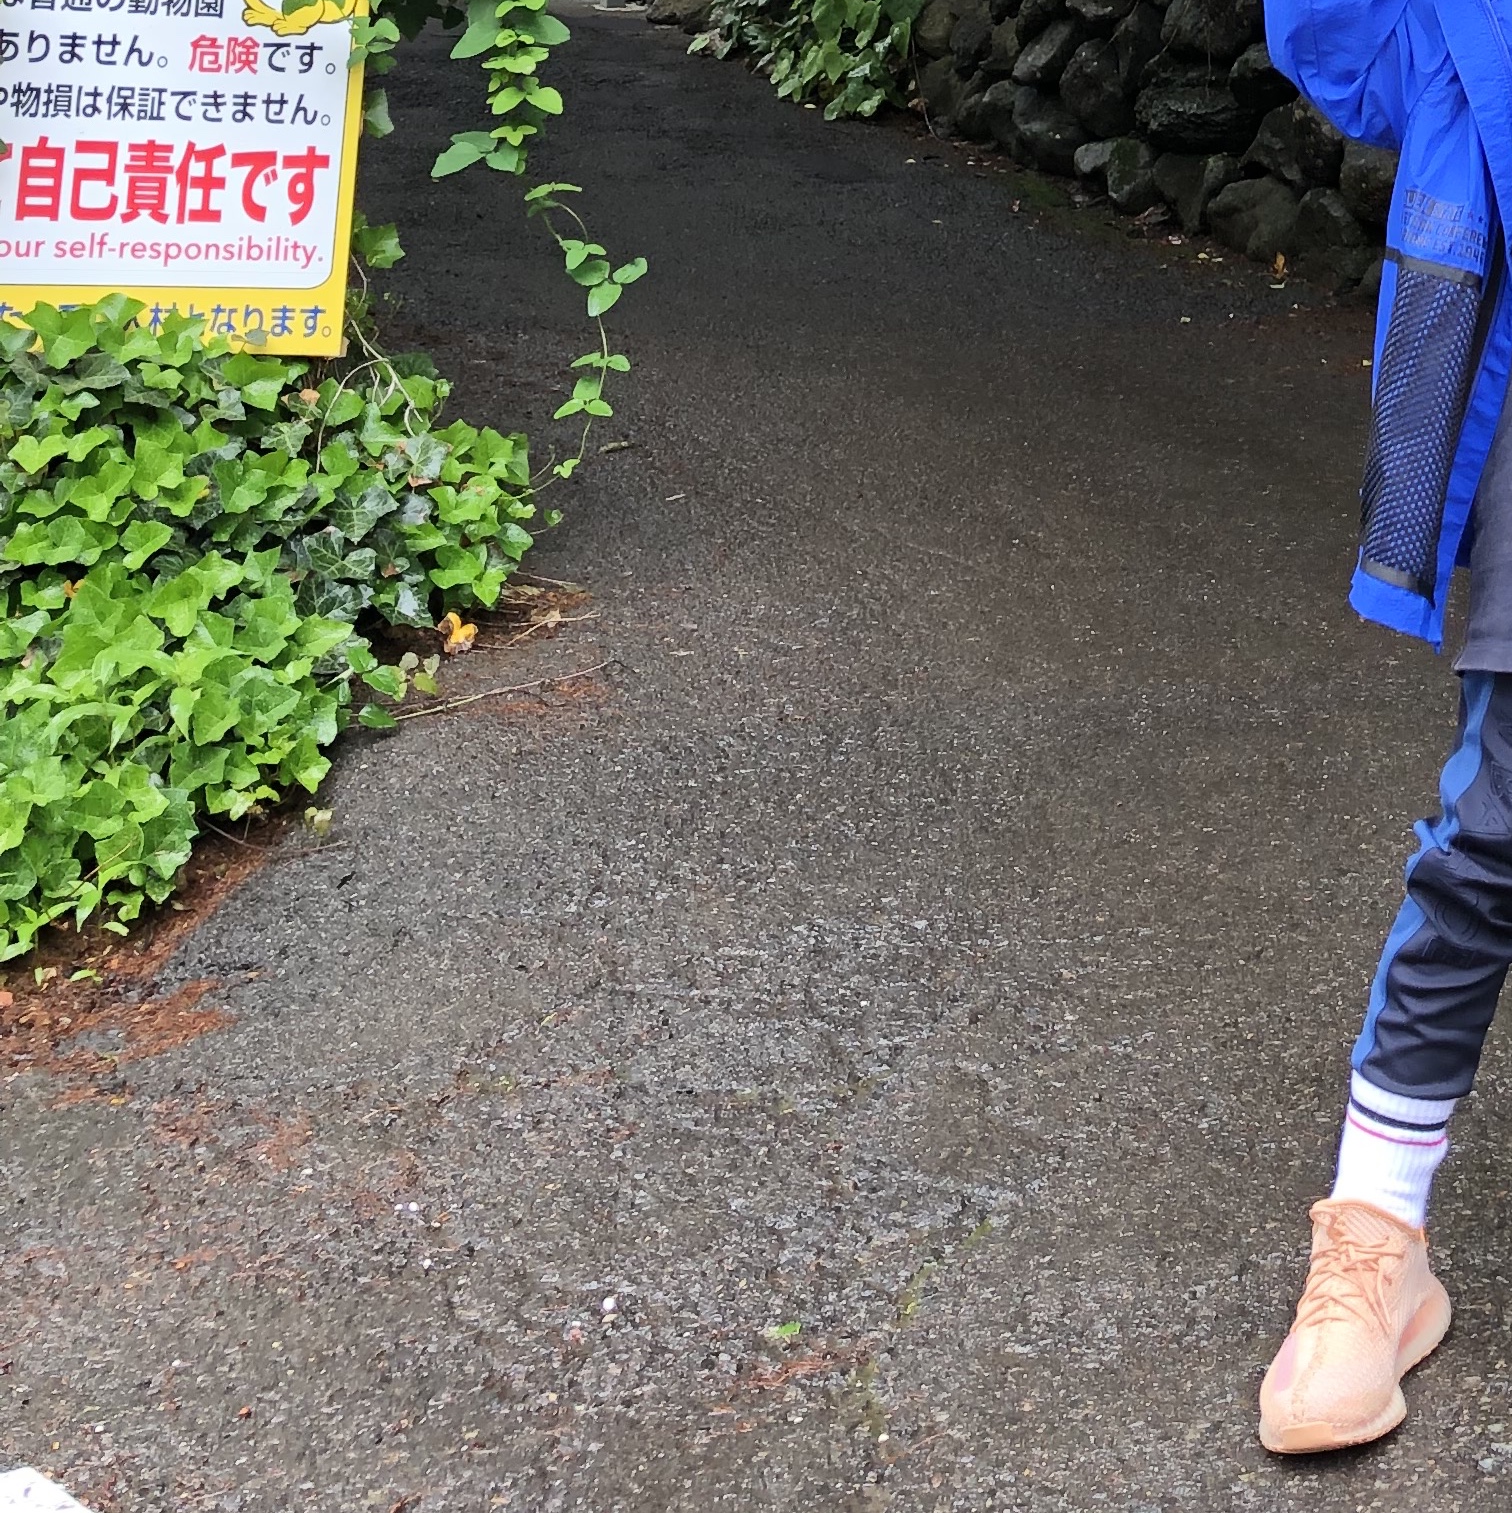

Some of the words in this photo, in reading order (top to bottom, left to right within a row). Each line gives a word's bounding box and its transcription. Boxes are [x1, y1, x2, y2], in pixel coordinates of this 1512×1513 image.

[0, 135, 331, 227] 自己責任です
[53, 232, 324, 269] self-responsibility.
